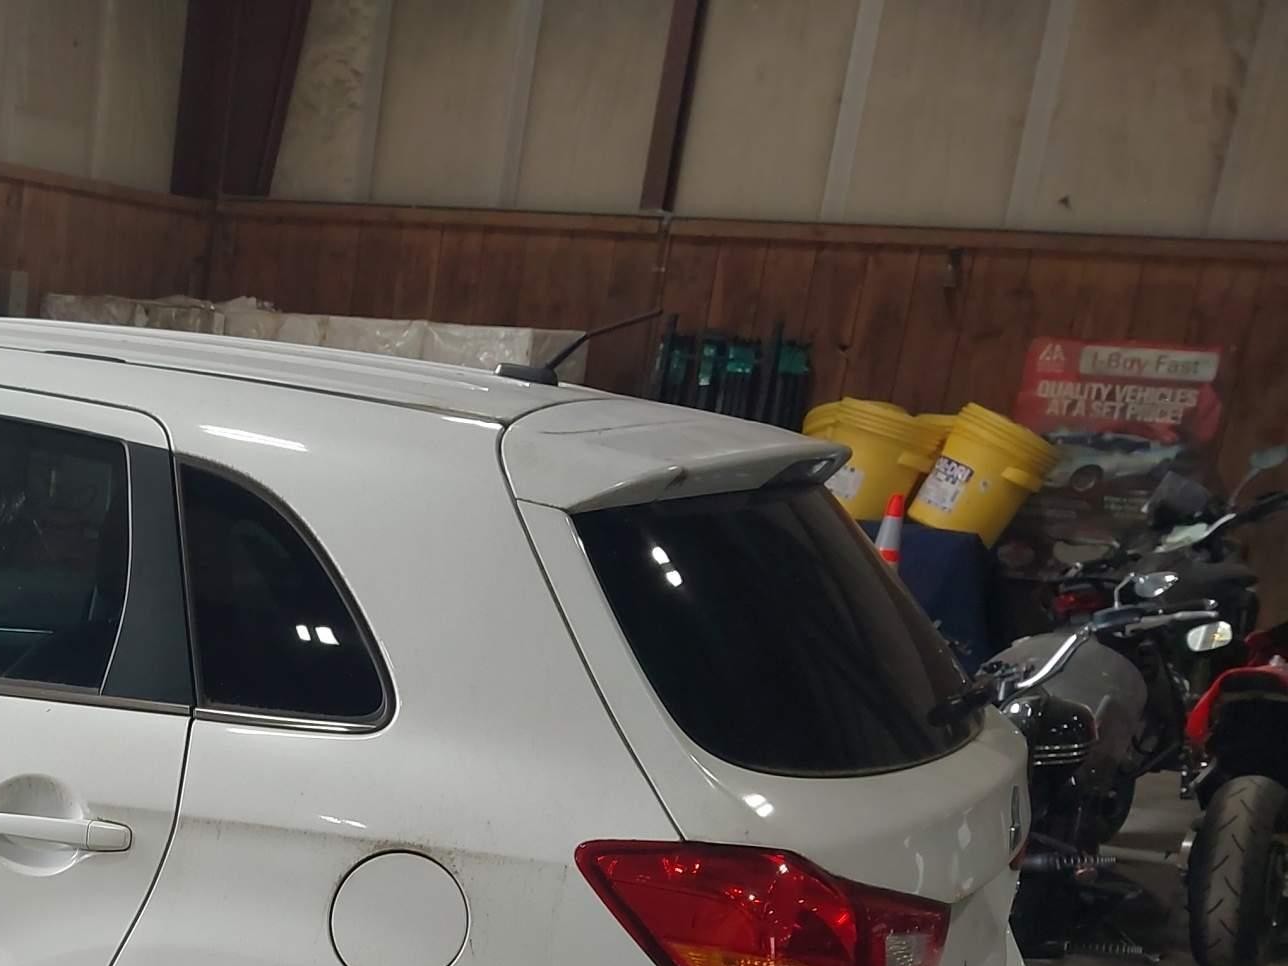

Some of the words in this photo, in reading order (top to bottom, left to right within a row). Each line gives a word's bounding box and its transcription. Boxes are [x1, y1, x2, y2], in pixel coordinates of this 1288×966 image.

[1155, 354, 1201, 375] Fast
[1036, 380, 1113, 401] QUALITY
[1114, 383, 1199, 408] VEHICLES
[1046, 399, 1071, 416] AT
[1090, 402, 1126, 421] SET
